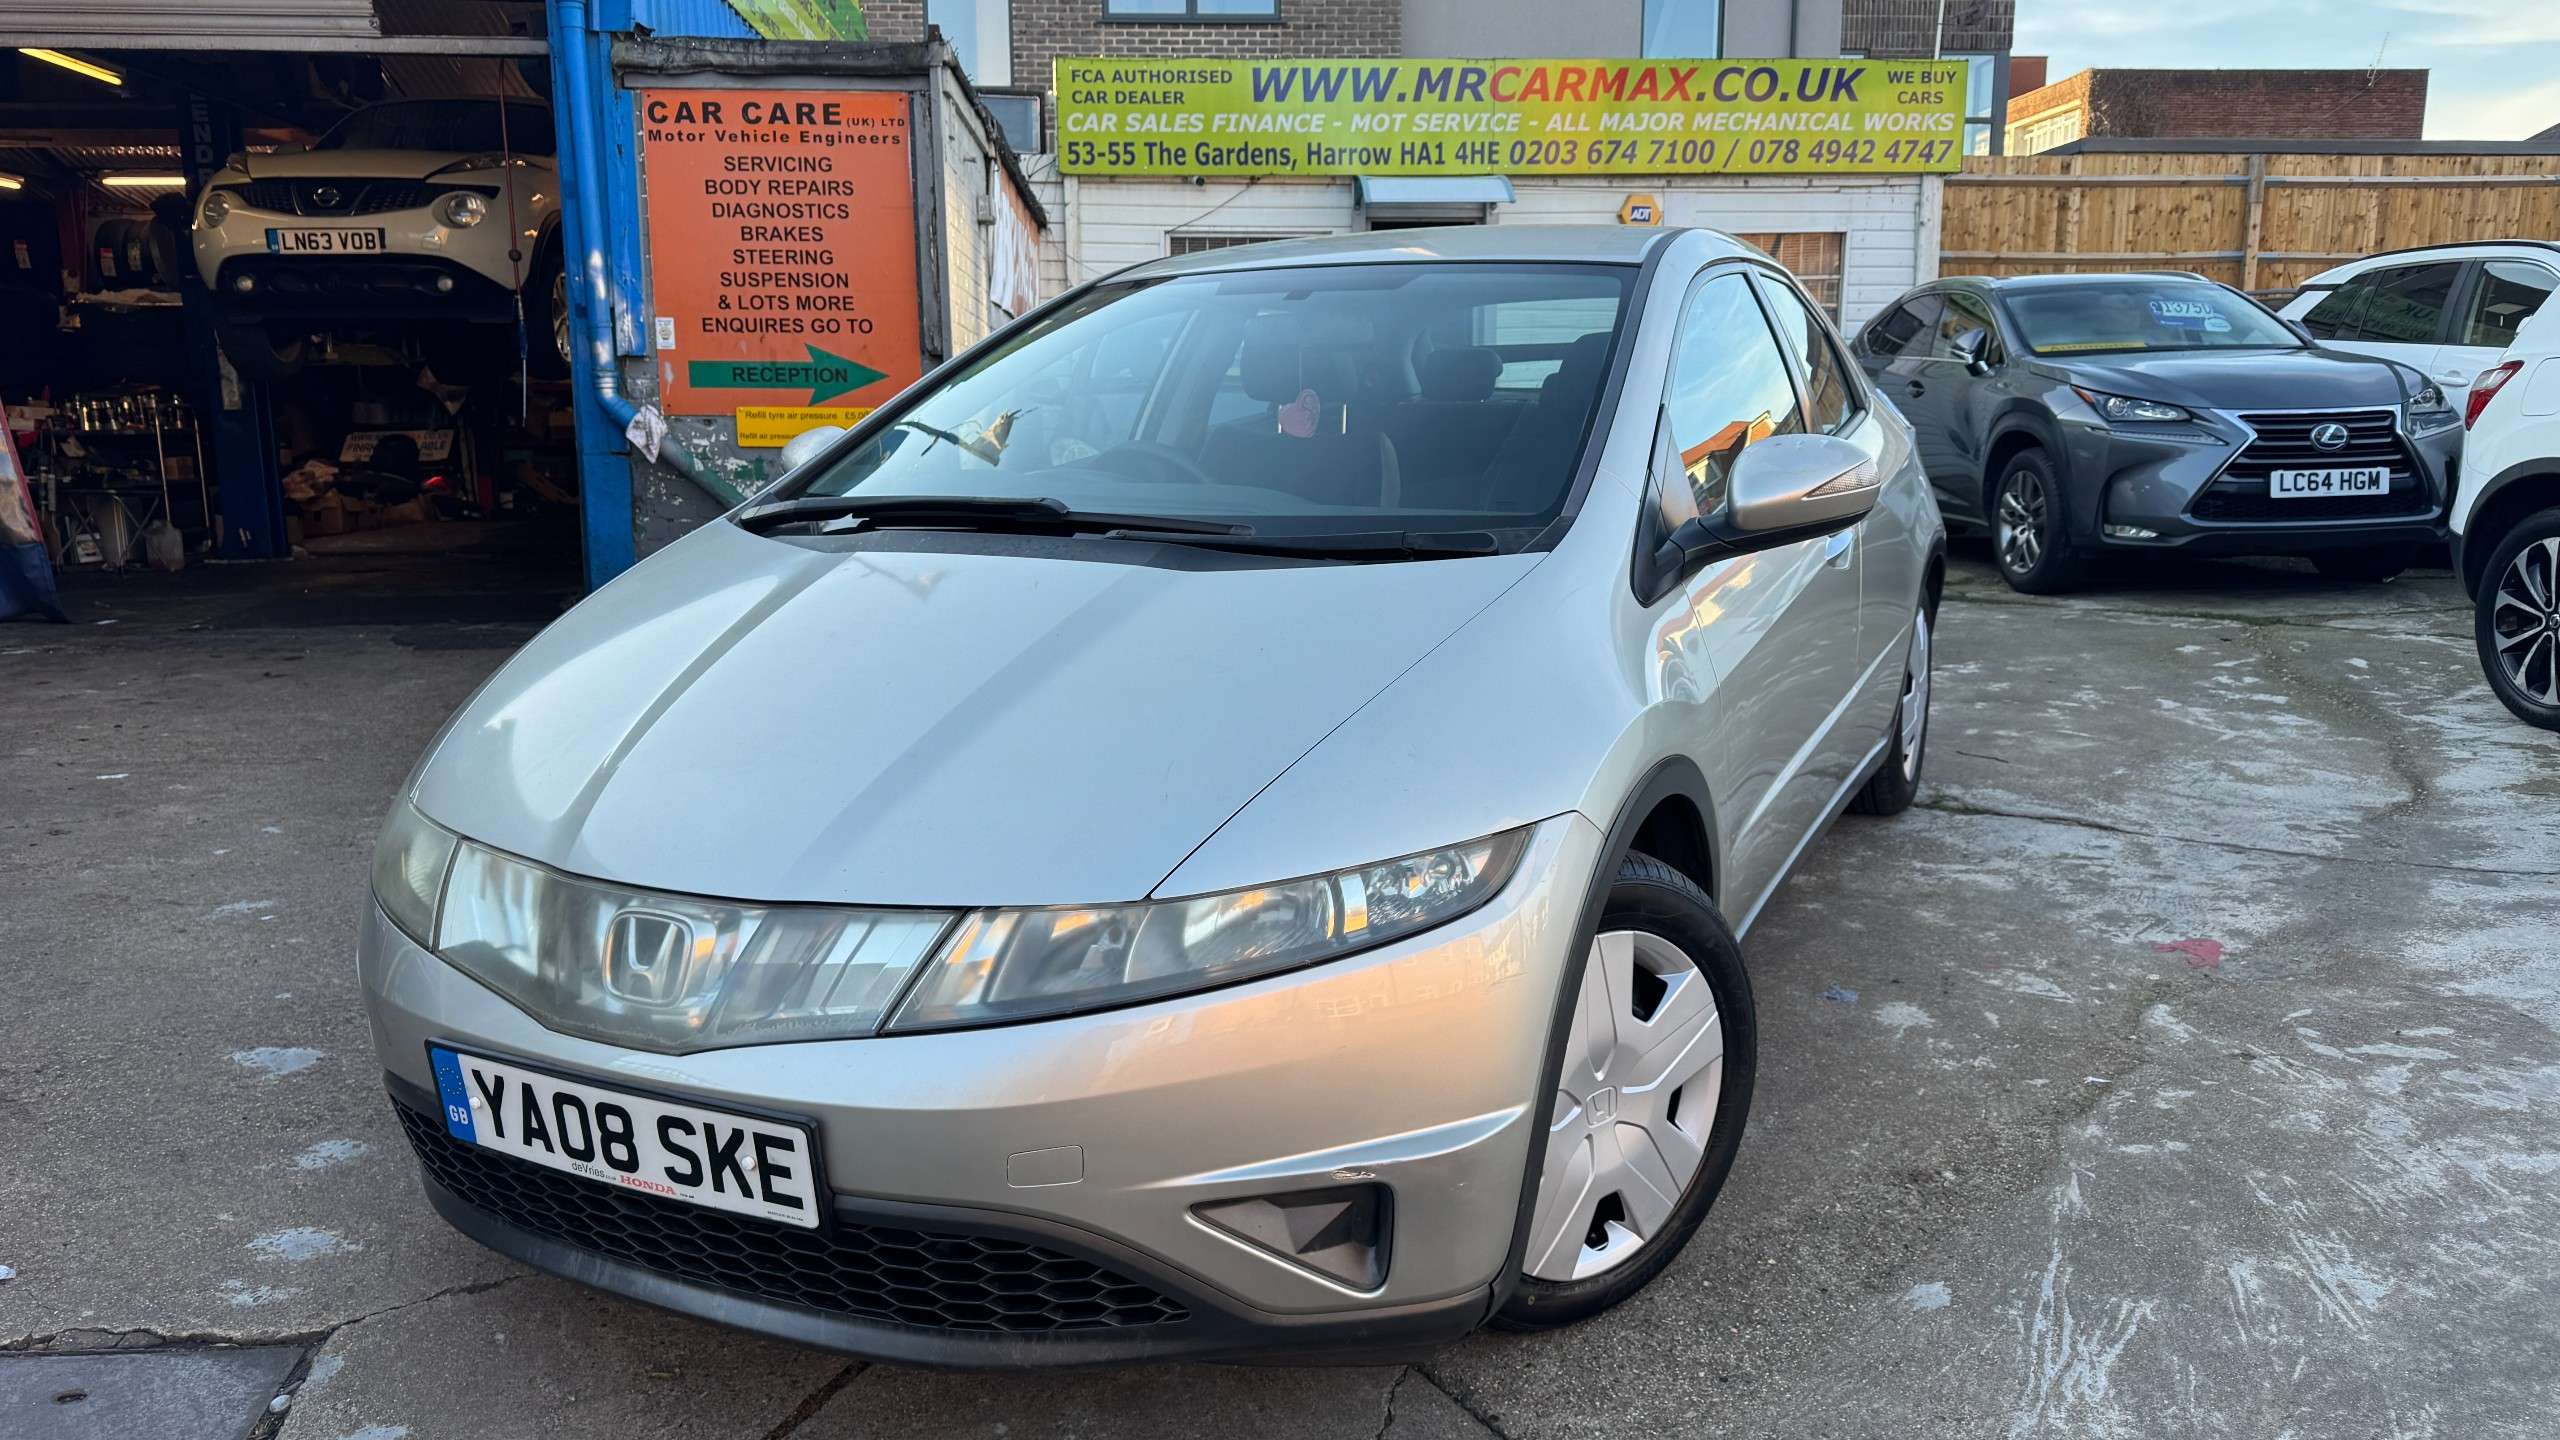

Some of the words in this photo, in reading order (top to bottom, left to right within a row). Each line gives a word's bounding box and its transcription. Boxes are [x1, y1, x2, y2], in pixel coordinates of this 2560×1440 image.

[1070, 69, 1106, 84] FCA
[1110, 69, 1233, 84] AUTHORISED
[1250, 66, 1867, 105] WWW.MRCARMAX.CO.UK
[1887, 70, 1916, 85] WE
[1920, 70, 1958, 85] BUY
[1071, 91, 1110, 105] CAR
[1115, 91, 1186, 105] DEALER
[1896, 91, 1945, 106] CARS
[647, 100, 724, 126] CAR
[740, 100, 842, 126] CARE
[846, 116, 876, 128] (UK)
[881, 117, 906, 128] LTD
[1065, 112, 1119, 134] CAR
[1124, 112, 1205, 134] SALES
[1210, 112, 1324, 134] FINANCE
[1350, 112, 1406, 134] MOT
[1411, 112, 1520, 134] SERVICE
[1544, 111, 1592, 133] ALL
[1598, 111, 1684, 133] MAJOR
[1692, 111, 1855, 133] MECHANICAL
[1863, 111, 1956, 133] WORKS
[648, 129, 706, 143] Motor
[714, 129, 790, 144] Vehicle
[799, 130, 902, 147] Engineers
[723, 155, 833, 173] SERVICING
[1066, 141, 1137, 167] 53-55
[1142, 141, 1187, 167] The
[1193, 141, 1298, 172] Gardens,
[1305, 141, 1393, 167] Harrow
[1399, 141, 1448, 166] HA1
[1454, 141, 1501, 166] 4HE
[1508, 139, 1578, 166] 0203
[1586, 139, 1637, 166] 674
[1646, 139, 1716, 165] 7100
[1722, 138, 1740, 168] /
[1748, 139, 1800, 165] 078
[1807, 139, 1877, 164] 4942
[1884, 138, 1955, 164] 4747
[704, 179, 761, 196] BODY
[767, 179, 854, 197] REPAIRS
[711, 202, 850, 219] DIAGNOSTICS
[1632, 208, 1651, 220] ADT
[281, 232, 333, 250] LN63
[338, 232, 376, 250] VOB
[740, 226, 824, 243] BRAKES
[733, 249, 834, 266] STEERING
[719, 271, 850, 289] SUSPENSION
[717, 295, 732, 311] &
[737, 295, 791, 311] LOTS
[795, 295, 855, 312] MORE
[702, 317, 805, 335] ENQUIRES
[810, 318, 842, 335] GO
[846, 318, 874, 335] TO
[732, 366, 849, 384] RECEPTION
[2279, 472, 2334, 492] LC64
[2340, 471, 2381, 491] HGM
[448, 1104, 469, 1126] GB
[471, 1068, 641, 1174] YA08
[656, 1114, 804, 1210] SKE
[619, 1174, 677, 1196] HONDA
